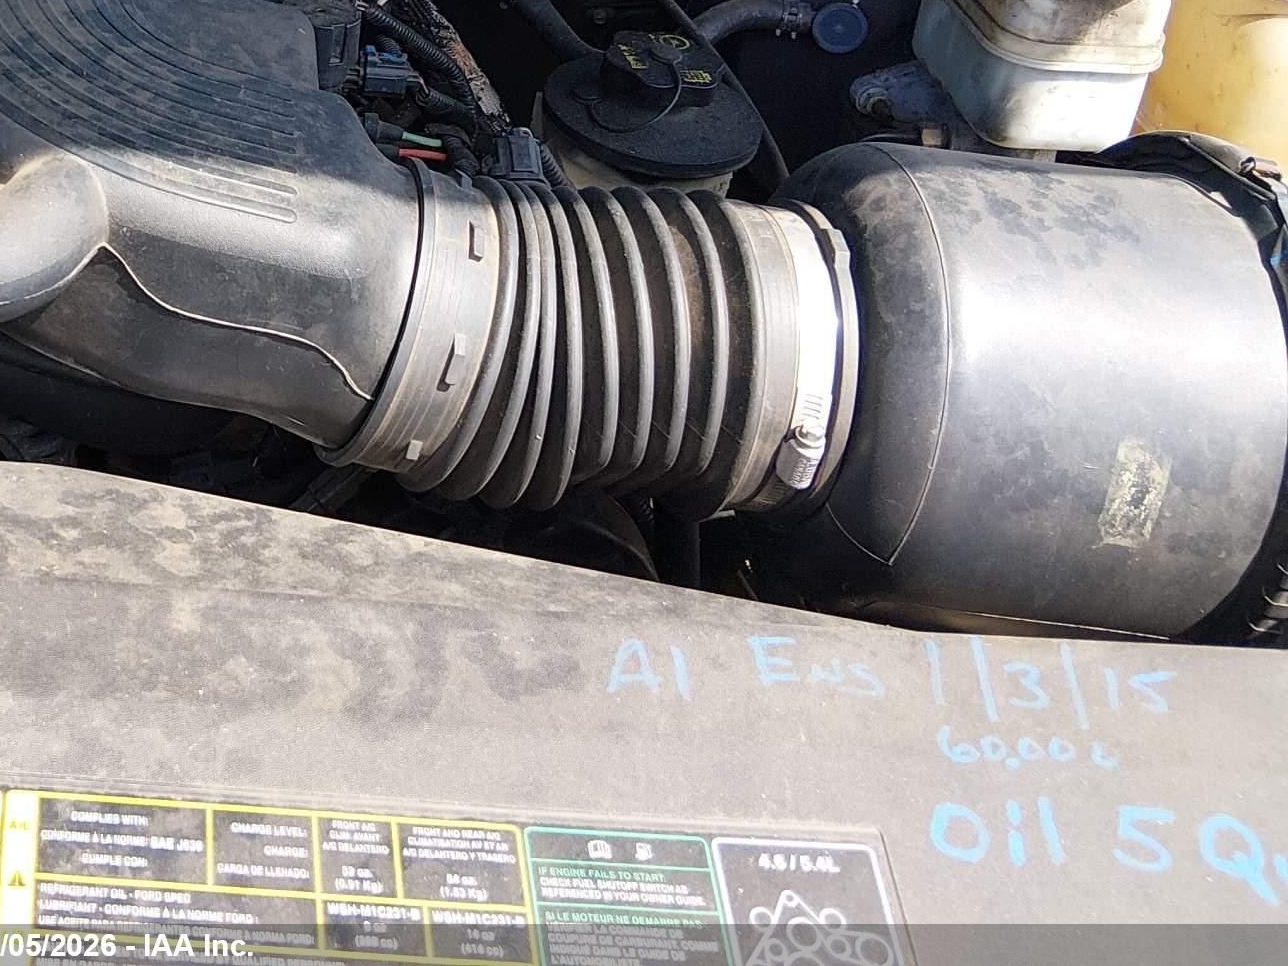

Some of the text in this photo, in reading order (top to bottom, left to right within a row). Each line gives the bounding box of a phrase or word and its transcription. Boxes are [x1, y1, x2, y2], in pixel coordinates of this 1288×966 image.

[70, 811, 120, 825] COMPLIES
[331, 819, 360, 831] FRONT
[230, 821, 308, 838] CHARGE LEVEL:
[353, 832, 381, 842] AVANT
[412, 826, 441, 838] FRONT
[442, 828, 461, 838] AND
[461, 829, 486, 840] REAR
[929, 796, 1066, 867] Oil
[1112, 804, 1177, 873] 5
[40, 830, 90, 844] CONFORME
[101, 833, 113, 845] LA
[150, 836, 175, 851] SAE
[263, 845, 309, 859] CHARGE:
[338, 842, 390, 855] DELANTERO
[80, 853, 122, 867] CUMPLE
[418, 849, 469, 861] DELANTERO
[476, 852, 517, 864] TRASERO
[217, 863, 310, 879] CARGA DE LLENADO:
[538, 866, 548, 876] IF
[549, 867, 586, 878] ENGINE
[588, 869, 616, 879] FAILS
[618, 871, 631, 880] TO
[39, 882, 109, 898] REFRIGERANT
[110, 888, 128, 900] OIL
[134, 889, 162, 902] FORD
[163, 891, 192, 904] SPEC
[539, 876, 689, 895] CHECK FUEL SHUTOFF SWITCH AS
[541, 887, 601, 900] REFERENCED
[602, 890, 613, 901] IN
[613, 891, 640, 902] YOUR
[640, 892, 674, 904] OWNER
[39, 899, 98, 912] LUBRIFIANT
[104, 903, 161, 918] CONFORME
[172, 907, 186, 920] LA
[187, 909, 224, 923] NORME
[225, 912, 254, 924] FORD
[544, 911, 555, 921] SI
[556, 912, 569, 922] LE
[571, 913, 617, 924] MOTEUR
[617, 915, 630, 925] NE
[38, 915, 57, 926] USE
[57, 916, 90, 927] ACEITE
[91, 918, 115, 928] PARA
[253, 931, 286, 943] NORMA
[593, 924, 608, 934] LA
[608, 925, 668, 938] COMMANDE
[668, 929, 684, 939] DE
[547, 932, 598, 944] COUPURE
[598, 935, 614, 945] DE
[680, 940, 720, 952] COMME
[592, 945, 622, 957] DANS
[622, 947, 637, 958] LE
[637, 947, 669, 960] GUIDE
[670, 950, 686, 961] DE
